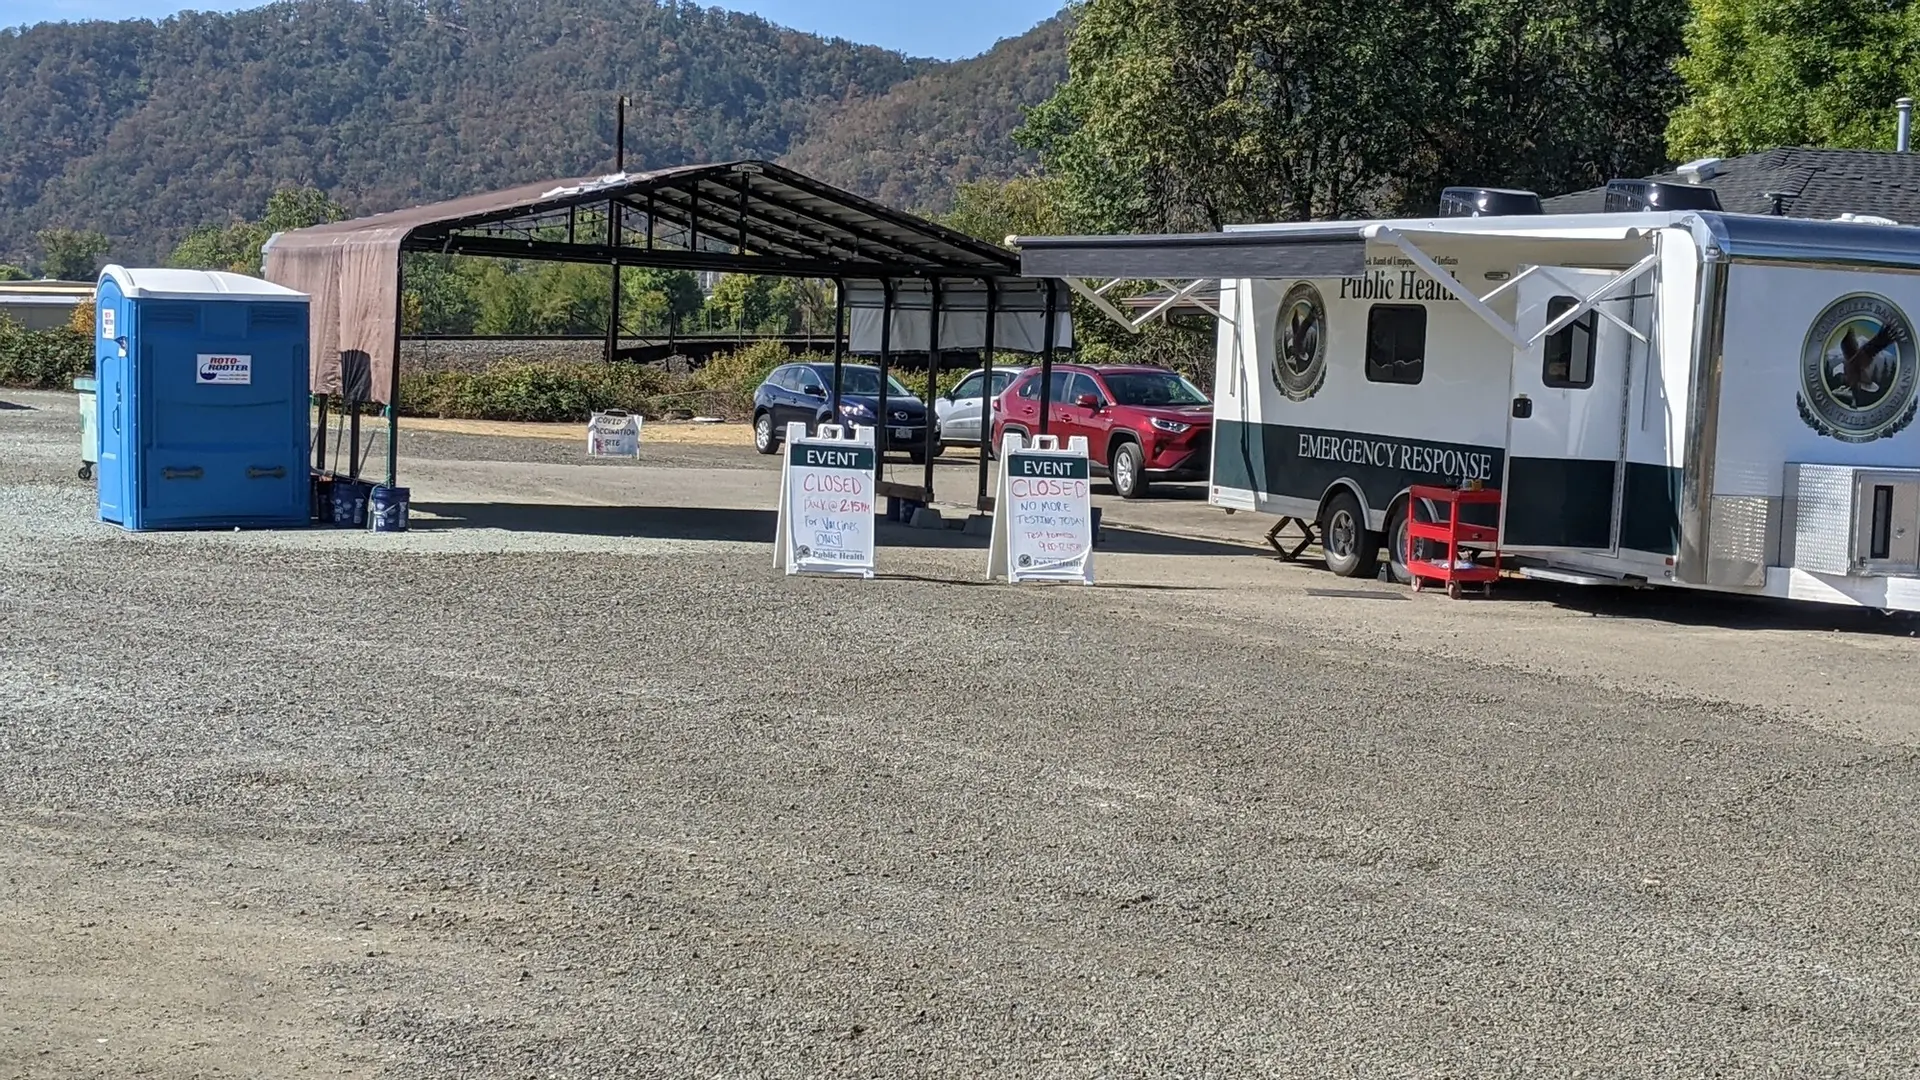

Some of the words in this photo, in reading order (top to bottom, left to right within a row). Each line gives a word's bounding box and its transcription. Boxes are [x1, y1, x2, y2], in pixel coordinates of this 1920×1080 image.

[1339, 269, 1395, 300] Public
[604, 438, 621, 447] SITE
[806, 449, 859, 466] EVENT
[1298, 433, 1399, 468] EMERGENCY
[1400, 444, 1492, 480] RESPONSE
[1023, 460, 1074, 476] EVENT
[803, 472, 862, 496] CLOSED
[1011, 478, 1087, 499] CLOSED
[1020, 501, 1037, 511] NO
[1041, 501, 1071, 513] MORE
[1058, 516, 1085, 527] TODAY
[812, 550, 838, 560] Public
[839, 551, 865, 561] Health
